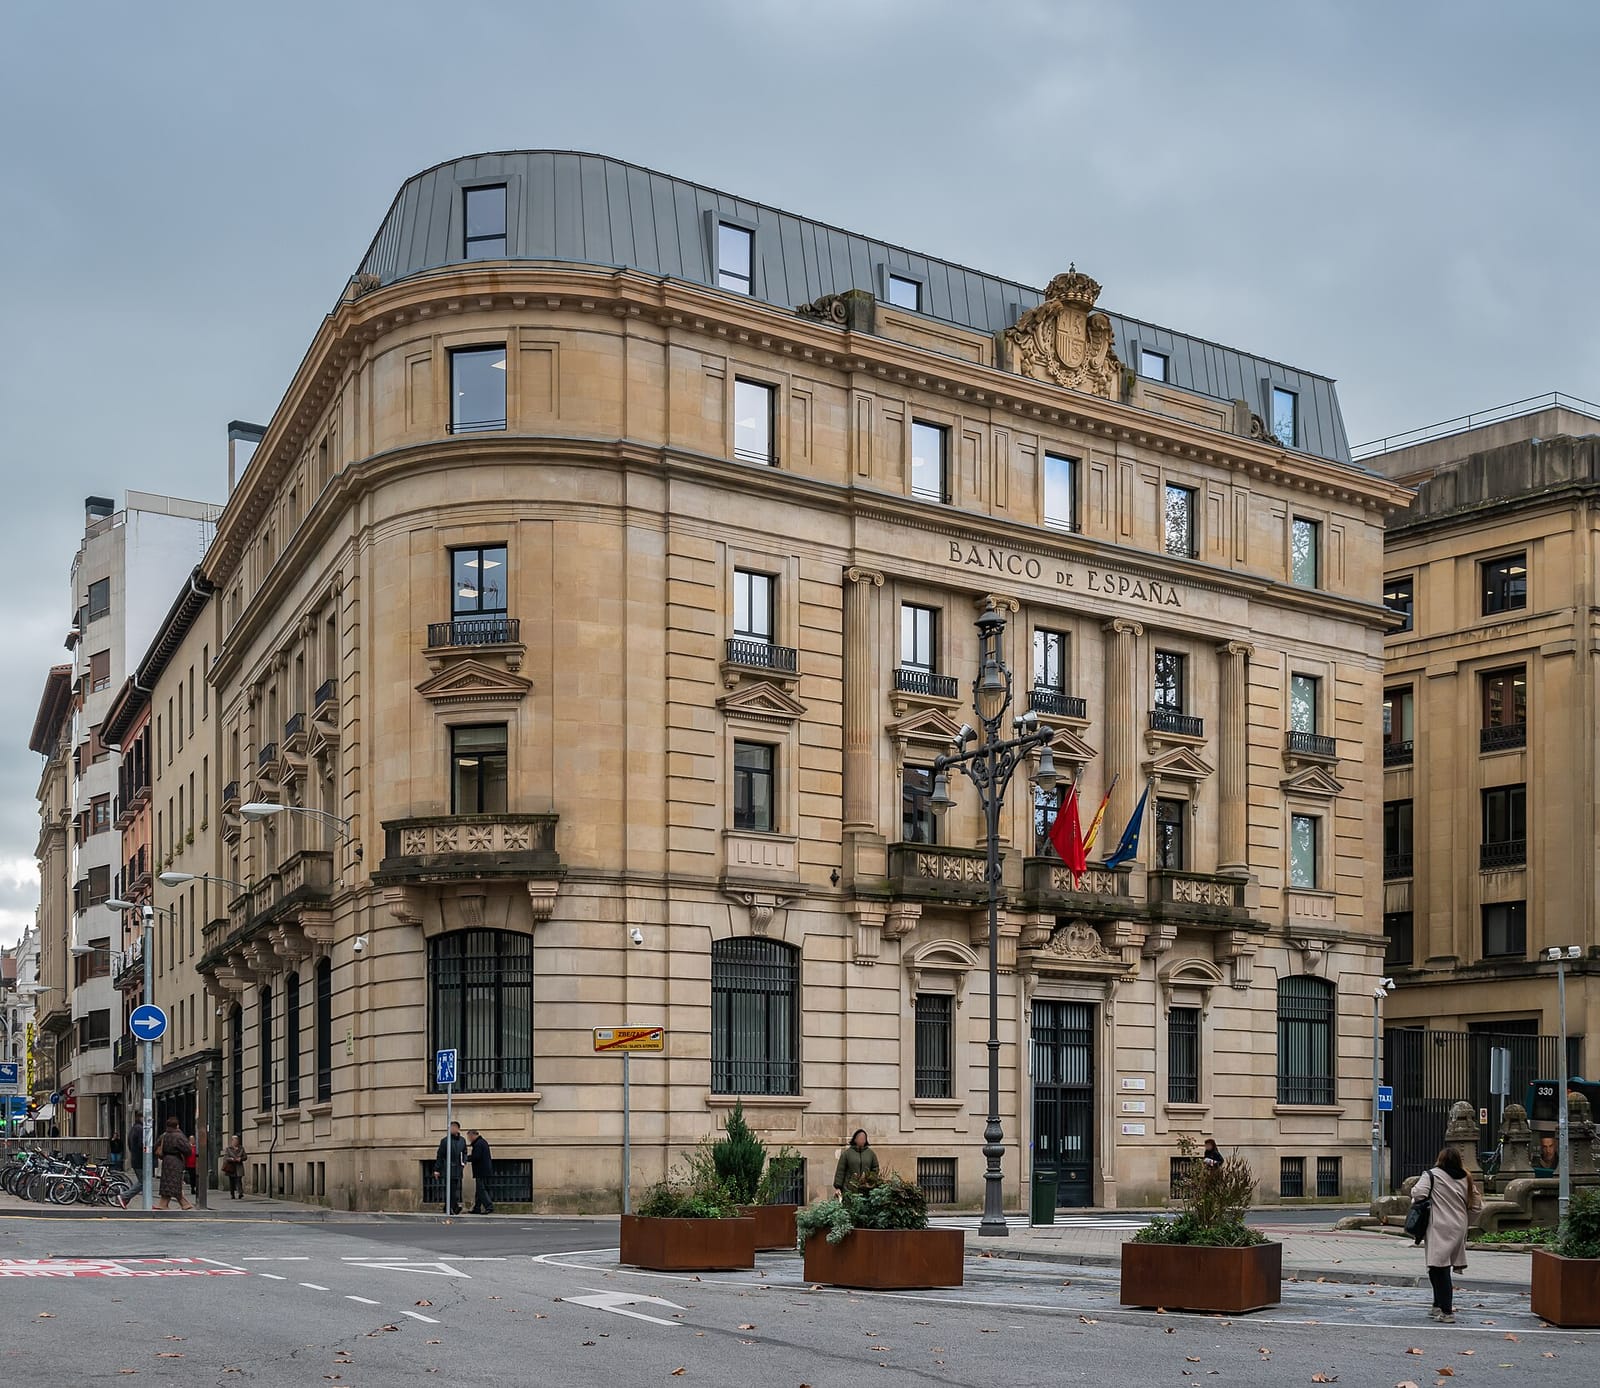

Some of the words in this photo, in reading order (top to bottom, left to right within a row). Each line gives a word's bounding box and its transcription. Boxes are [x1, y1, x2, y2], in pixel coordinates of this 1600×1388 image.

[949, 541, 1042, 579] BANCO
[1056, 571, 1074, 587] DE
[1087, 570, 1182, 607] ESPAÑA
[1537, 1087, 1554, 1096] 330
[1378, 1094, 1392, 1102] TAXI
